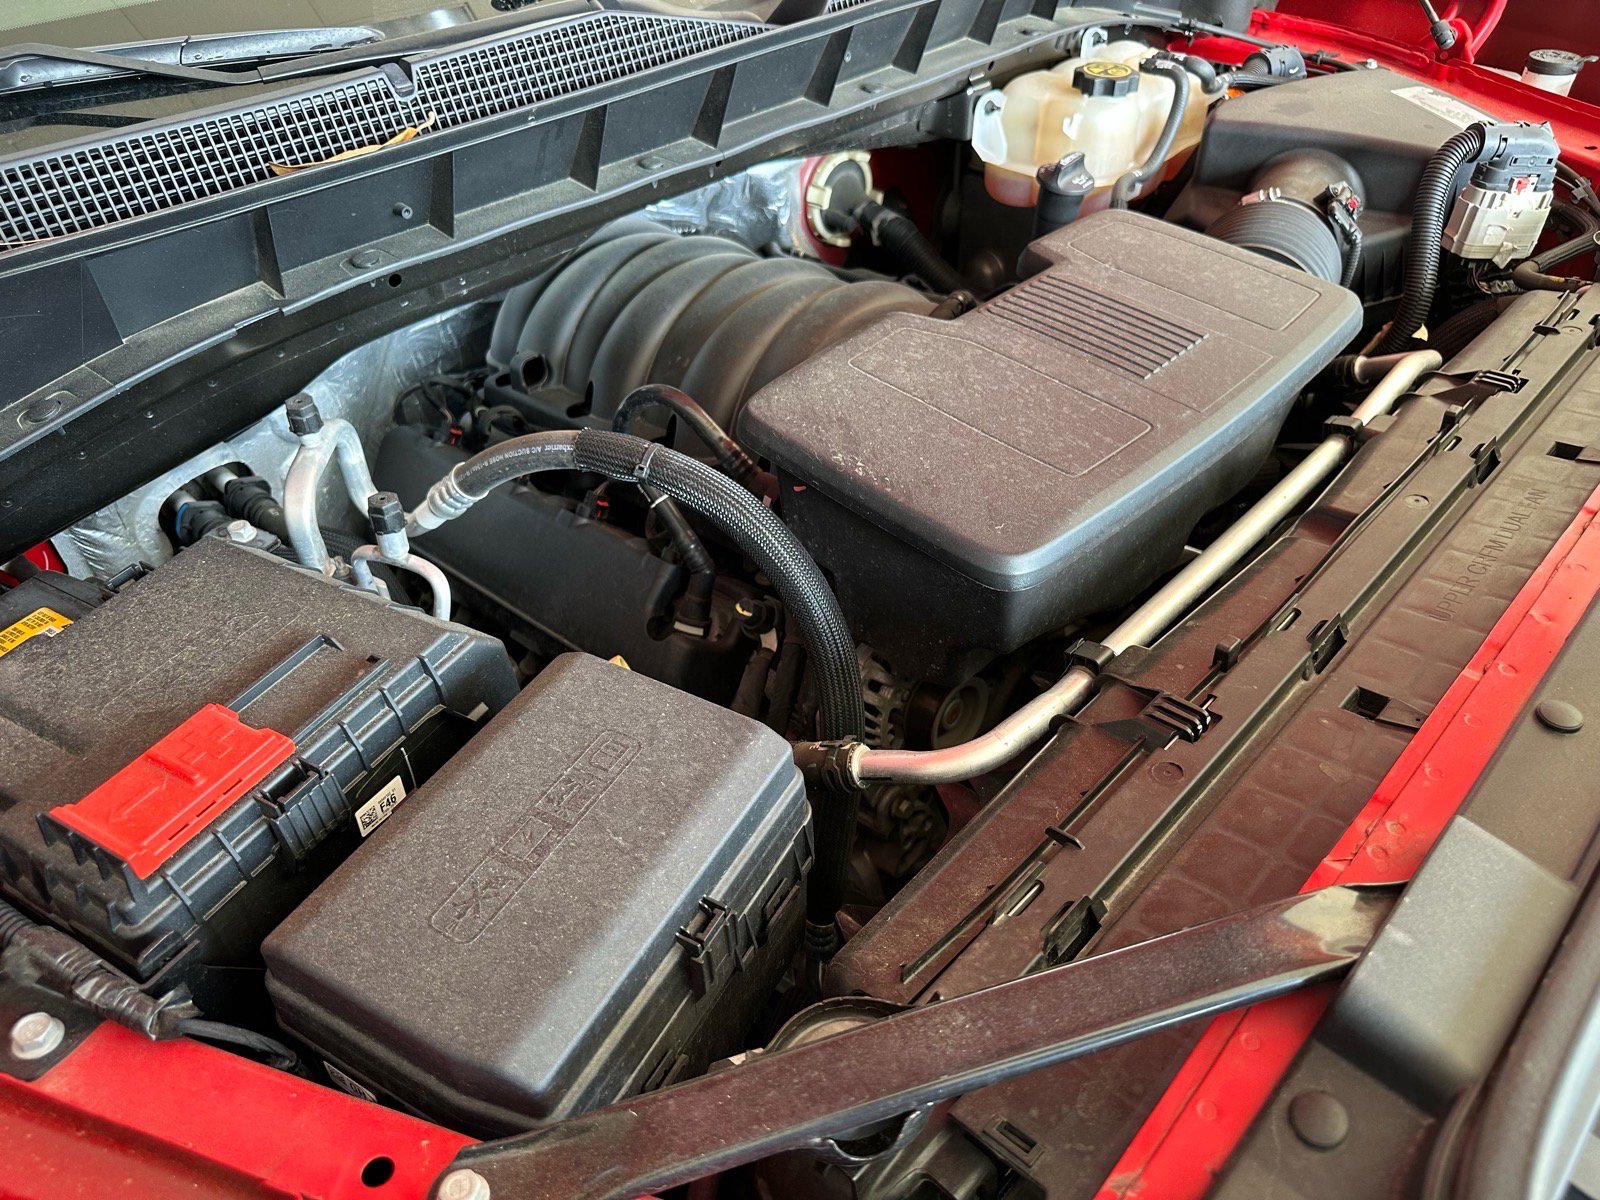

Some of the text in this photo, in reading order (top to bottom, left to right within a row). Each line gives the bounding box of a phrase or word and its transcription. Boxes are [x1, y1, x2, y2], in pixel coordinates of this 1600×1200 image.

[504, 447, 530, 458] SUCTION
[531, 445, 542, 453] A/C
[489, 455, 504, 465] HOSE
[1429, 575, 1480, 621] UPPER
[1494, 511, 1533, 539] DUAL
[1518, 488, 1549, 510] FAN
[380, 793, 396, 812] F46
